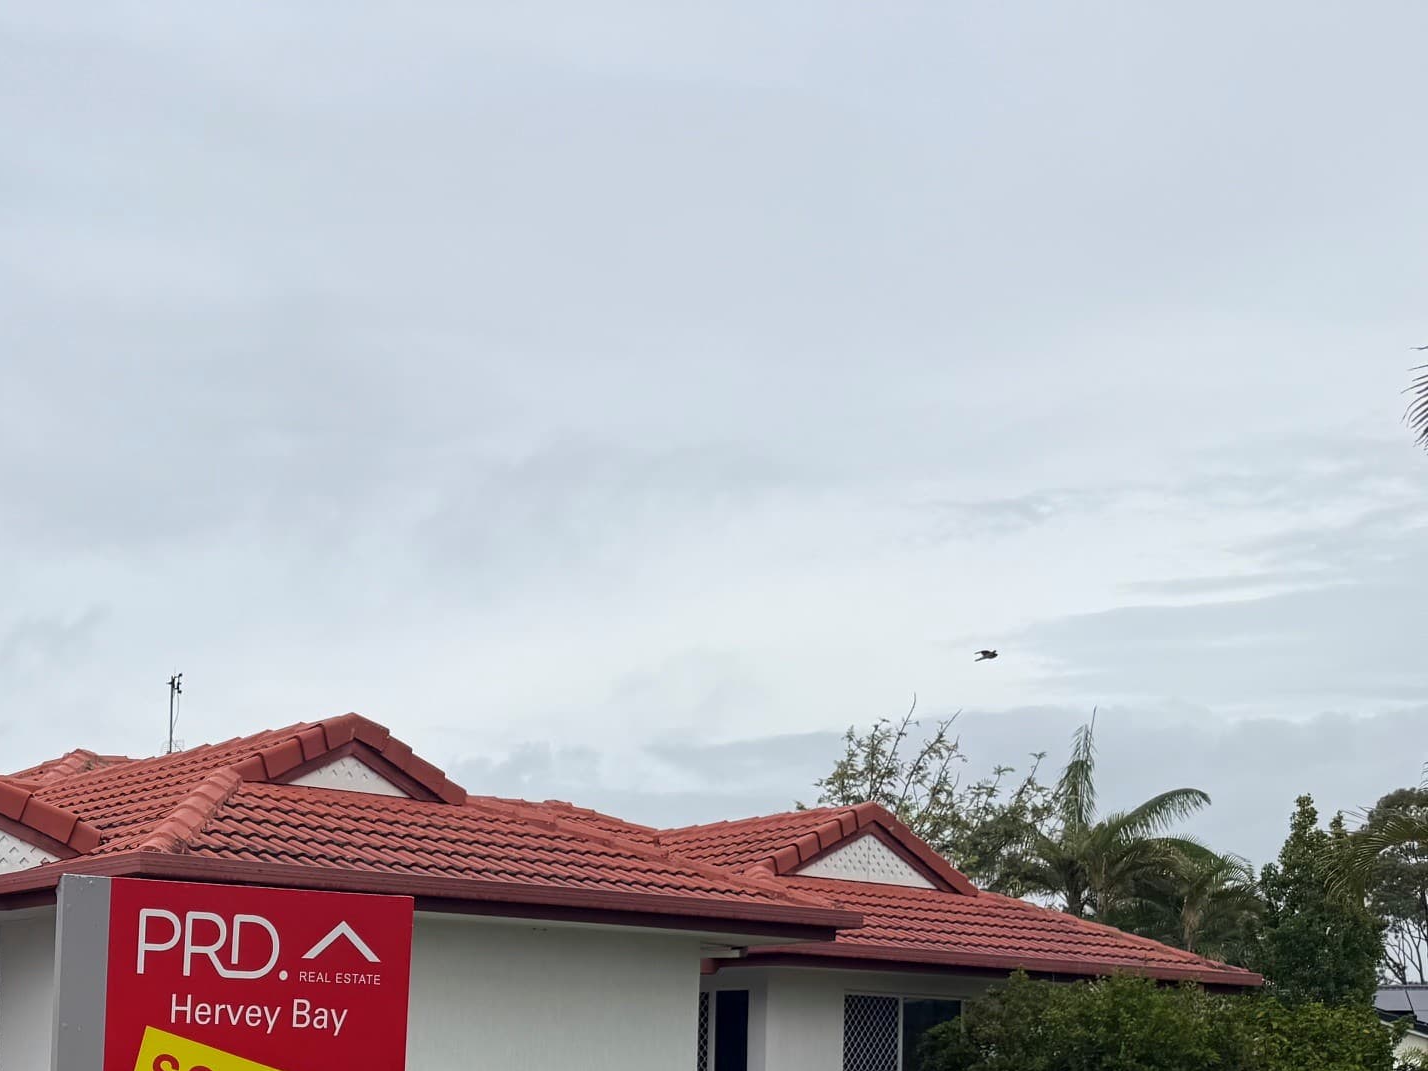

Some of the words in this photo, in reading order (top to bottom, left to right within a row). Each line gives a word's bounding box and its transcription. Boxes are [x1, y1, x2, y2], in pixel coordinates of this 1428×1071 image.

[136, 908, 289, 980] PRD.
[299, 970, 331, 984] REAL
[335, 972, 381, 986] ESTATE
[170, 993, 281, 1034] Hervey
[291, 998, 348, 1036] Bay
